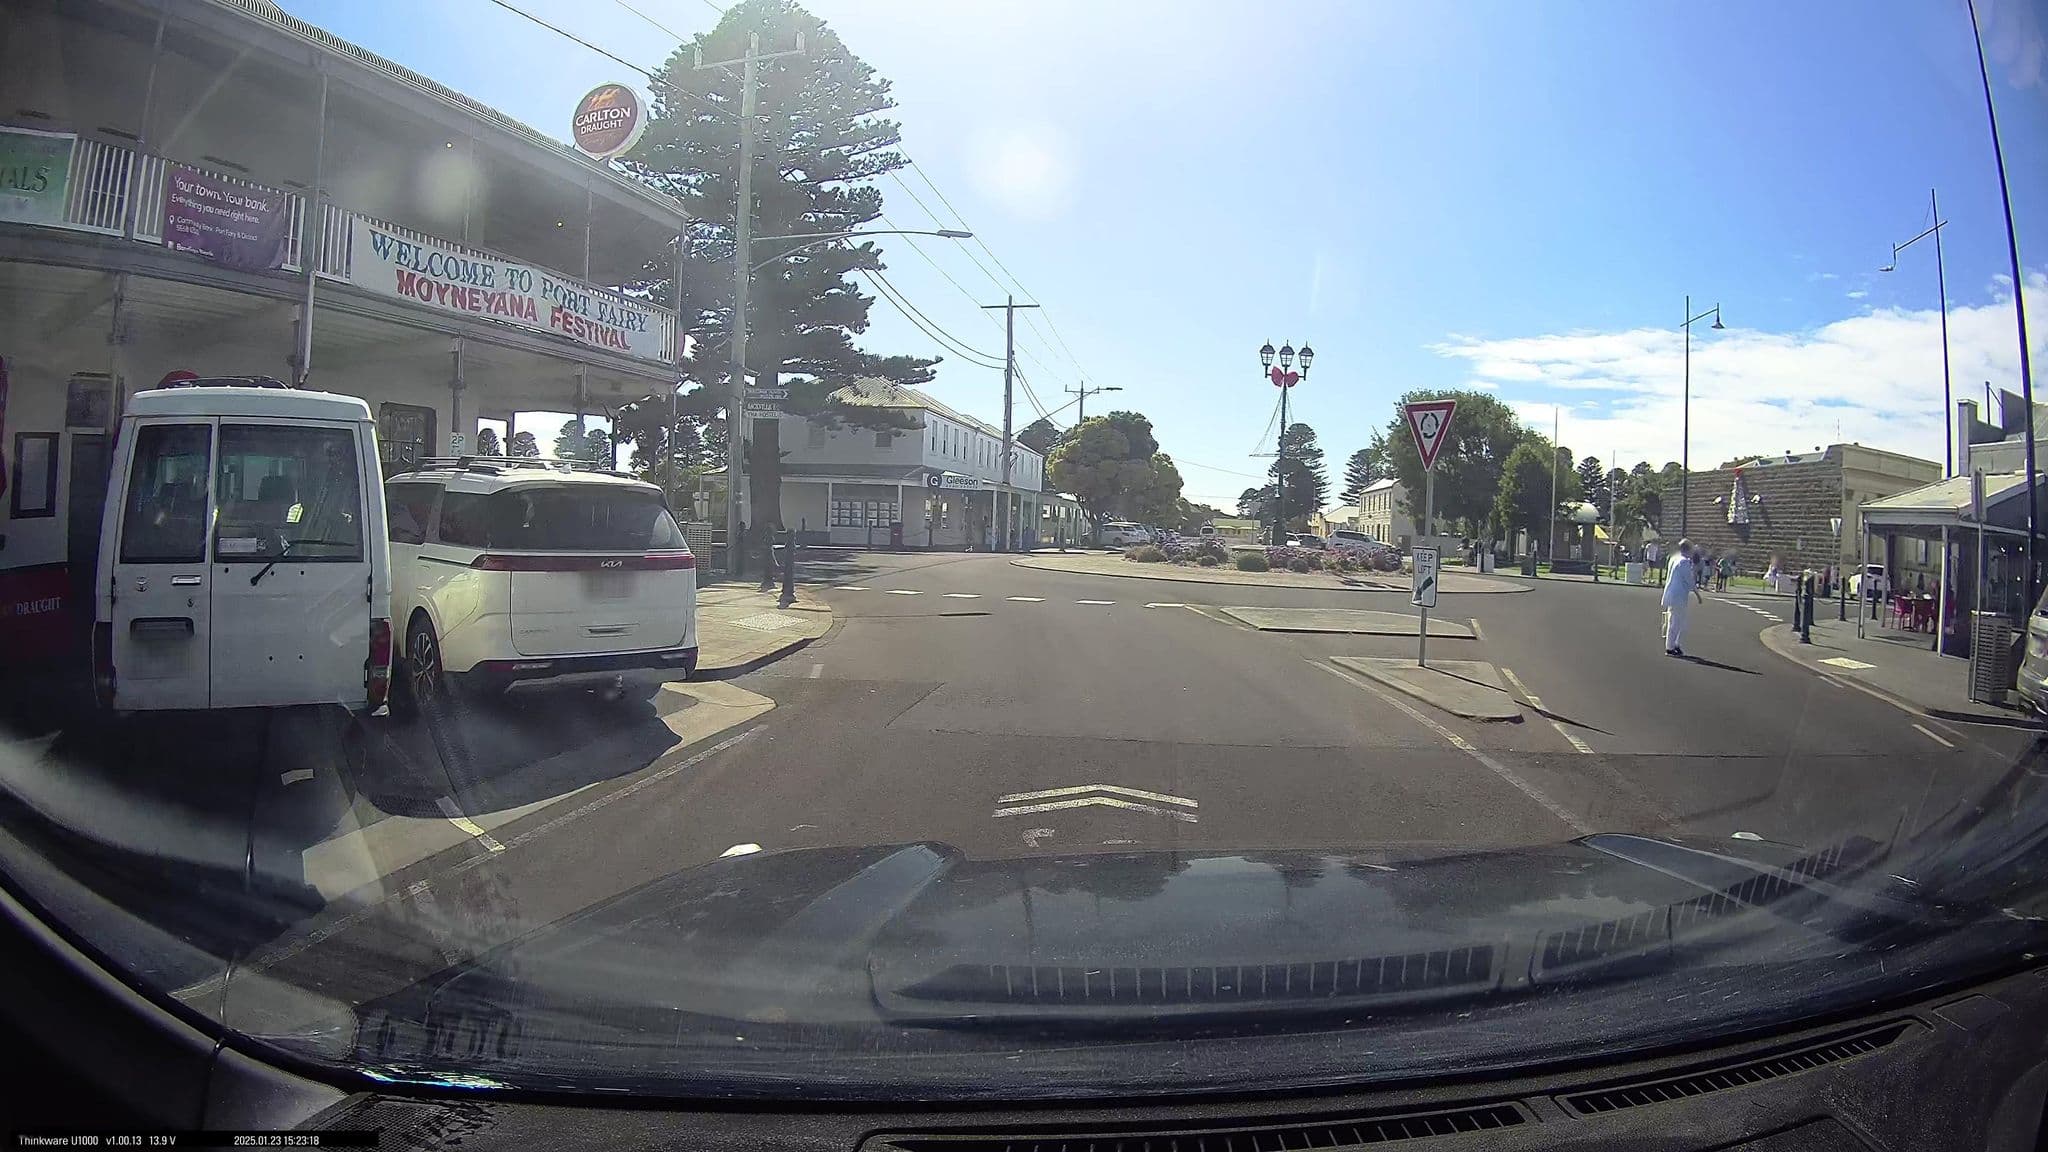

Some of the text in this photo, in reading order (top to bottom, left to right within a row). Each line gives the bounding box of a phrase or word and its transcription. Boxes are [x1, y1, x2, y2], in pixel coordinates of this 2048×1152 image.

[575, 107, 631, 127] CARLTON
[580, 119, 624, 135] DRAUGHT
[171, 193, 202, 213] Everything
[202, 204, 214, 215] you
[214, 206, 230, 218] need
[230, 209, 246, 222] right
[174, 175, 270, 213] Your town. Your bank.
[369, 229, 649, 333] WELCOME TO PORT FAIRY
[395, 269, 632, 351] MOYNEYANA FESTIVAL
[946, 476, 979, 486] Gleeson
